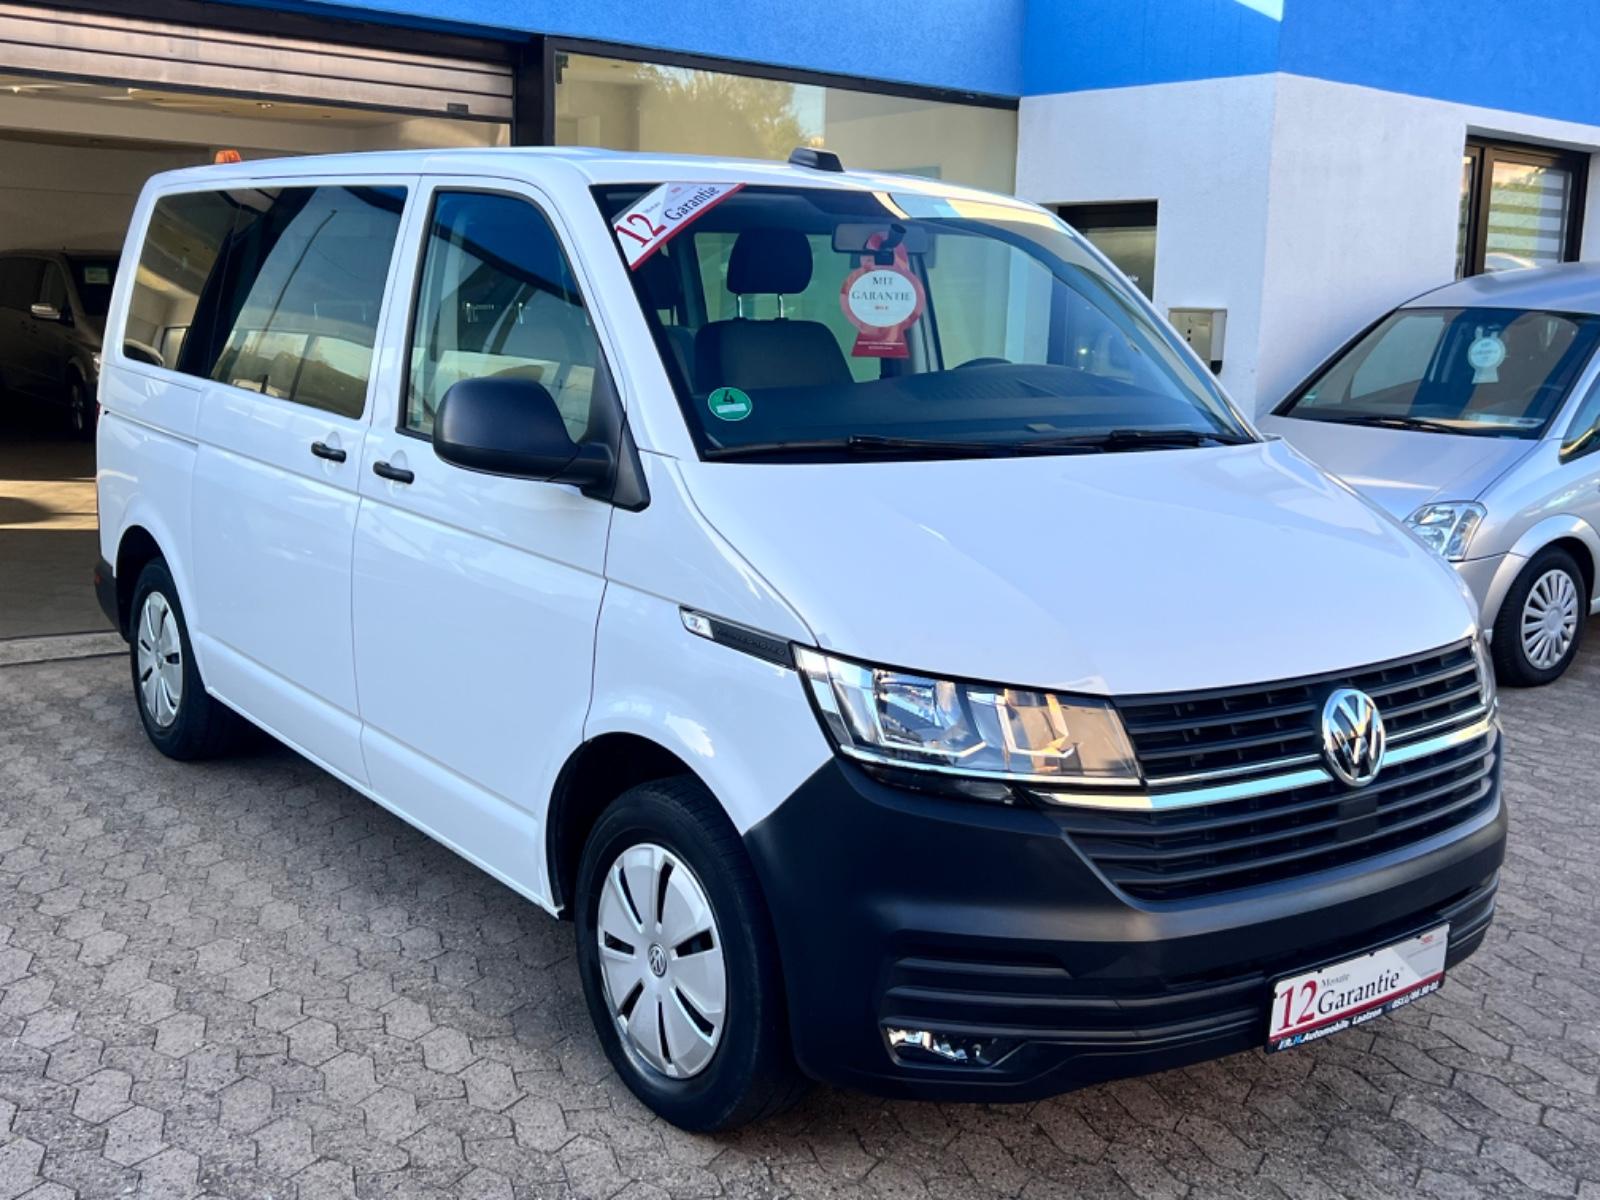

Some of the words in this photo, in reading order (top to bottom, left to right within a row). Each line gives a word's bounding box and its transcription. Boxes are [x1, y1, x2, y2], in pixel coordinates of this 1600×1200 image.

[615, 213, 667, 248] 12
[664, 186, 725, 221] Garantie
[872, 276, 894, 286] MIT
[851, 291, 911, 302] GARANTIE
[722, 390, 735, 404] 4
[1278, 979, 1318, 1031] 12
[1317, 968, 1401, 1016] Garantie
